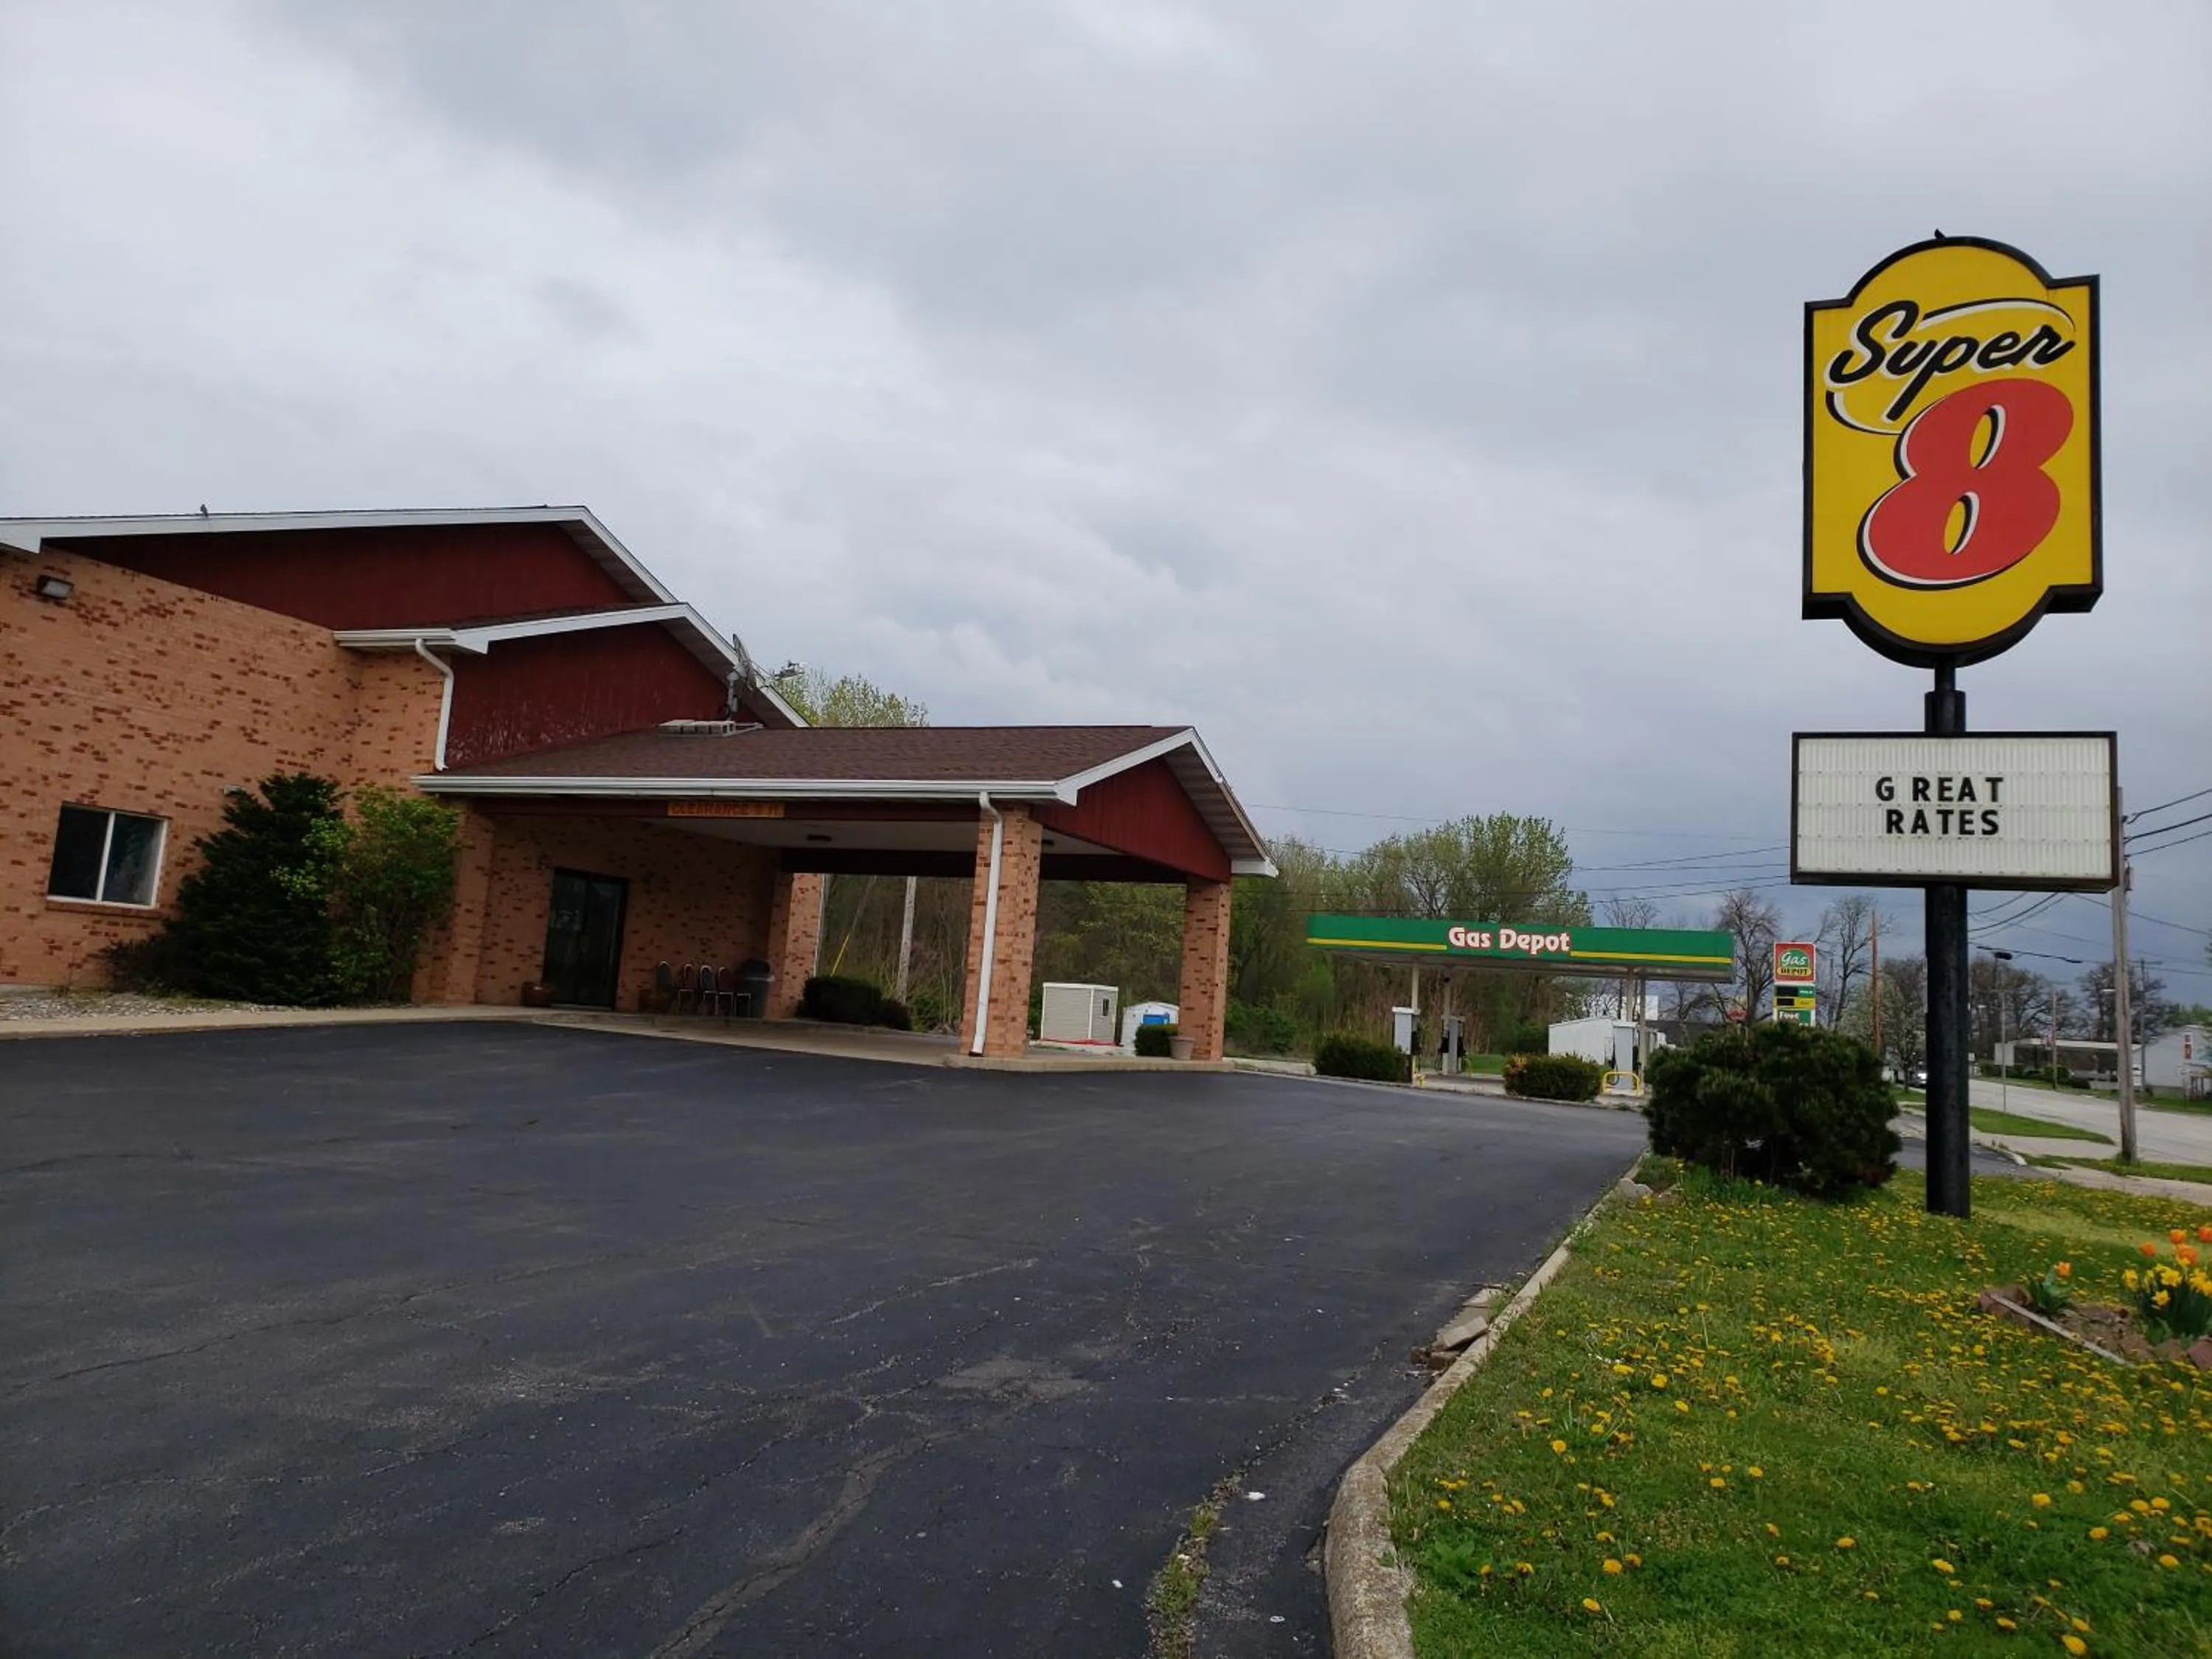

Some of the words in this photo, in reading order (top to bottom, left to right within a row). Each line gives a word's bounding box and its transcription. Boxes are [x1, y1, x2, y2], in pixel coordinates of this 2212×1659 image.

[1826, 299, 2076, 422] Super
[1856, 378, 2074, 591] 8
[1885, 810, 2000, 835] RATES
[1448, 926, 1492, 948] Gas
[1498, 928, 1571, 955] Depot
